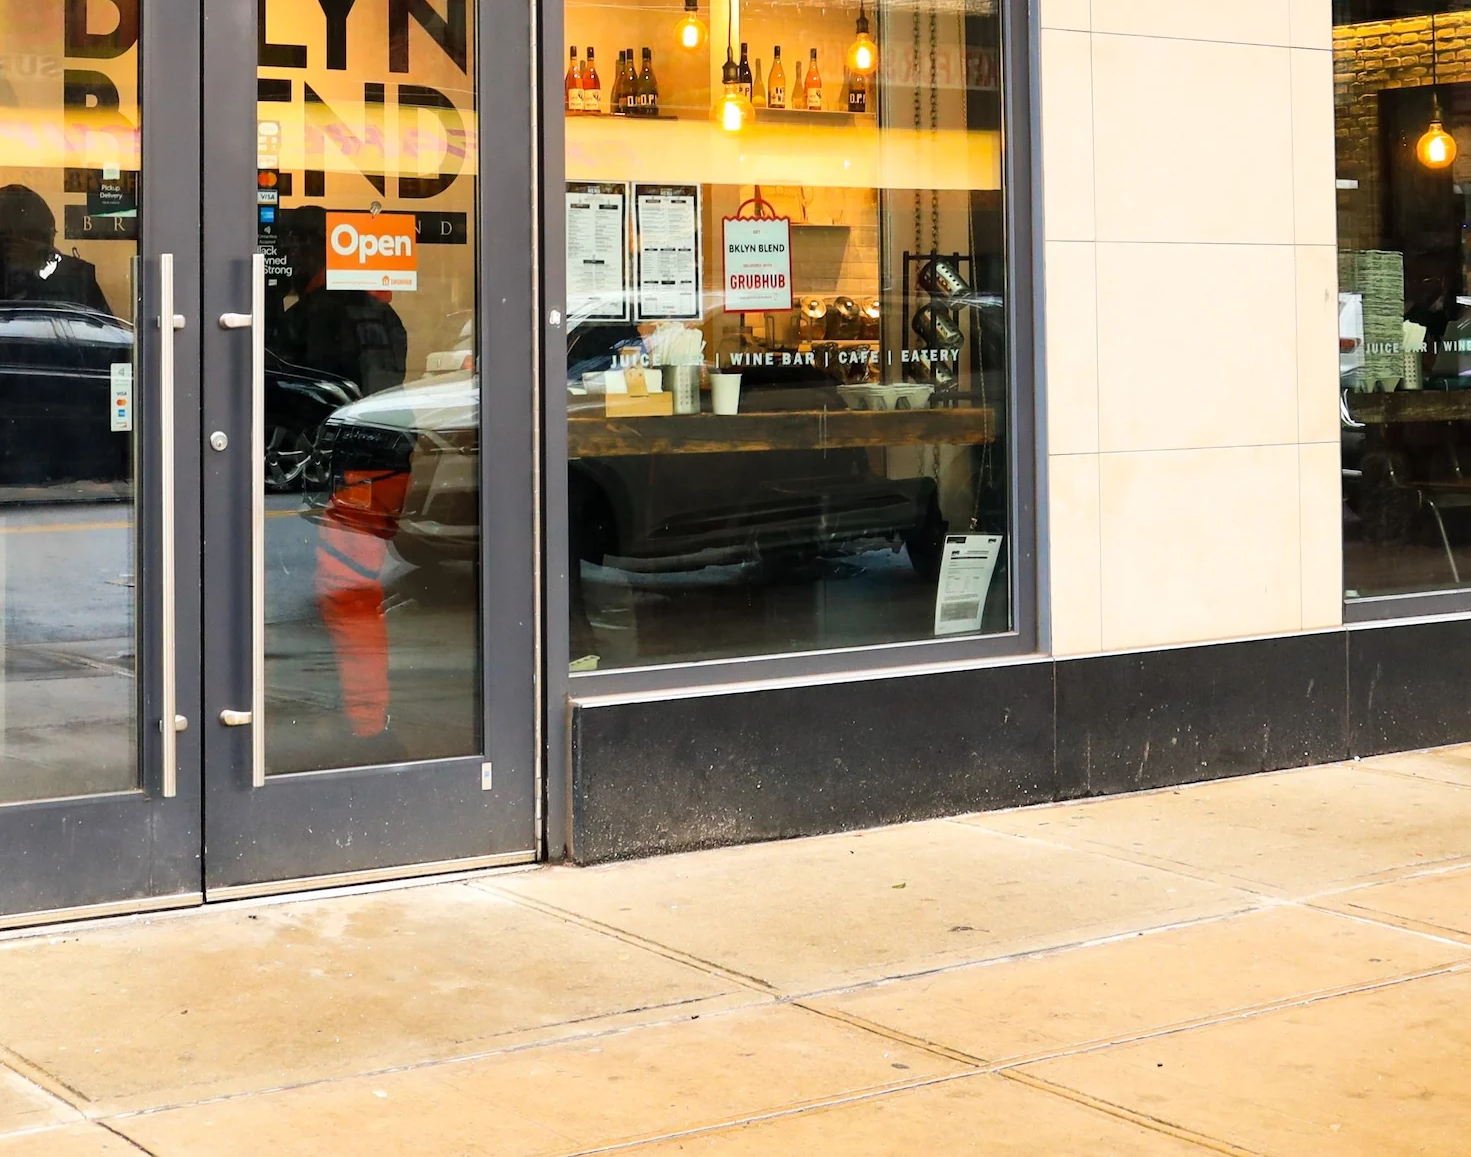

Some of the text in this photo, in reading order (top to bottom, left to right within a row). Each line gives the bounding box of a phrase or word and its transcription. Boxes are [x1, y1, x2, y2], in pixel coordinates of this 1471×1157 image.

[101, 184, 120, 192] Pickup
[99, 192, 123, 200] Delivery
[331, 224, 411, 264] Open
[729, 244, 785, 253] BKLYN BLEND
[264, 265, 293, 277] Strong
[730, 274, 785, 289] GRUBHUB
[1366, 343, 1399, 354] JUICE
[610, 353, 661, 368] JUICE
[730, 352, 774, 366] WINE
[782, 351, 815, 365] BAR
[838, 350, 878, 364] CAFE
[901, 349, 959, 363] EATERY
